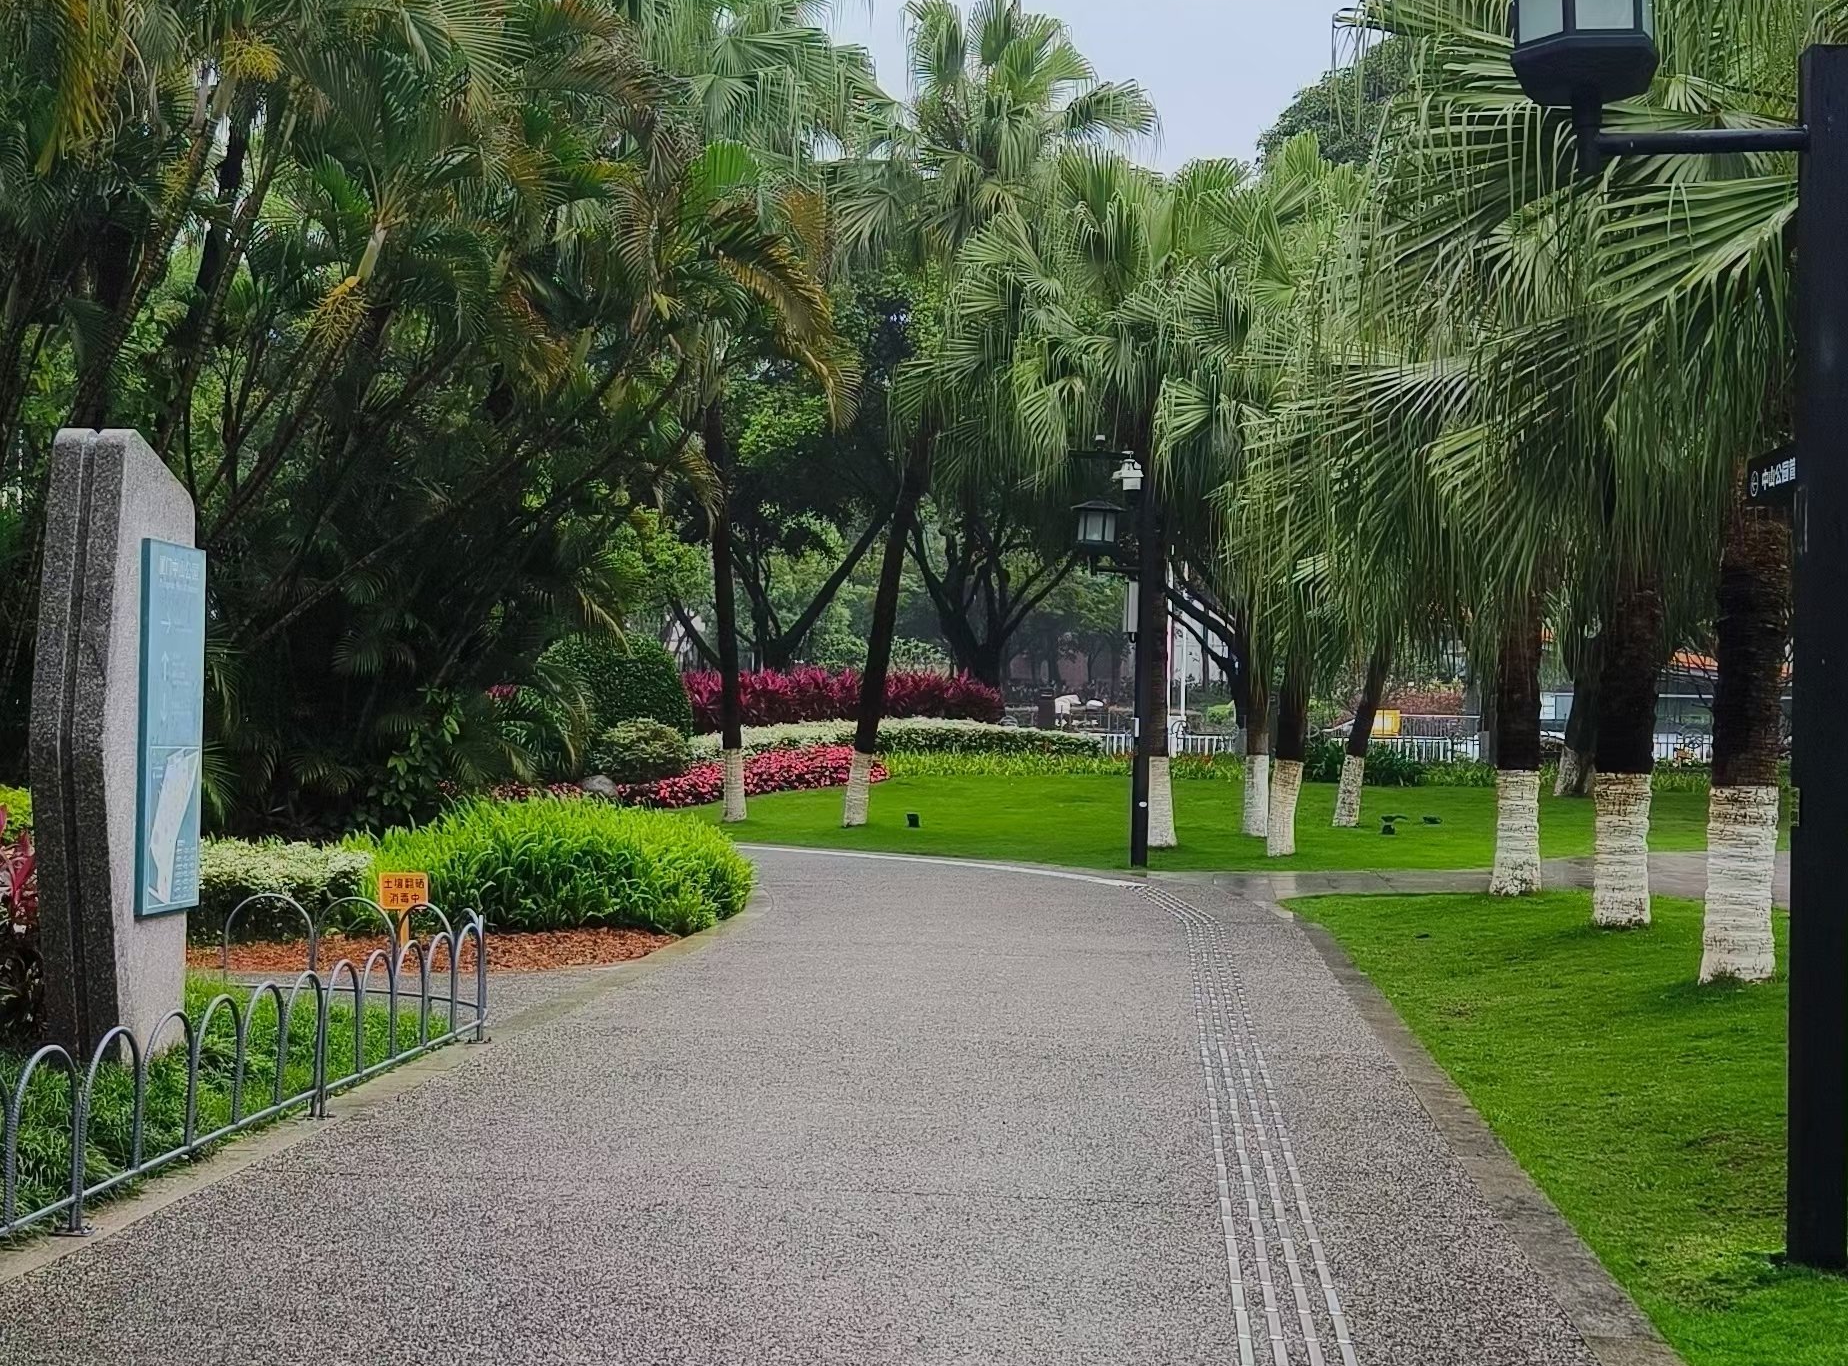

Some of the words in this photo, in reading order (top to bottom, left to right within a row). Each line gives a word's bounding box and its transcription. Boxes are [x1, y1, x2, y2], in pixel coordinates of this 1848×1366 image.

[383, 878, 425, 889] 土壤翻晒
[389, 892, 420, 904] 消毒中
